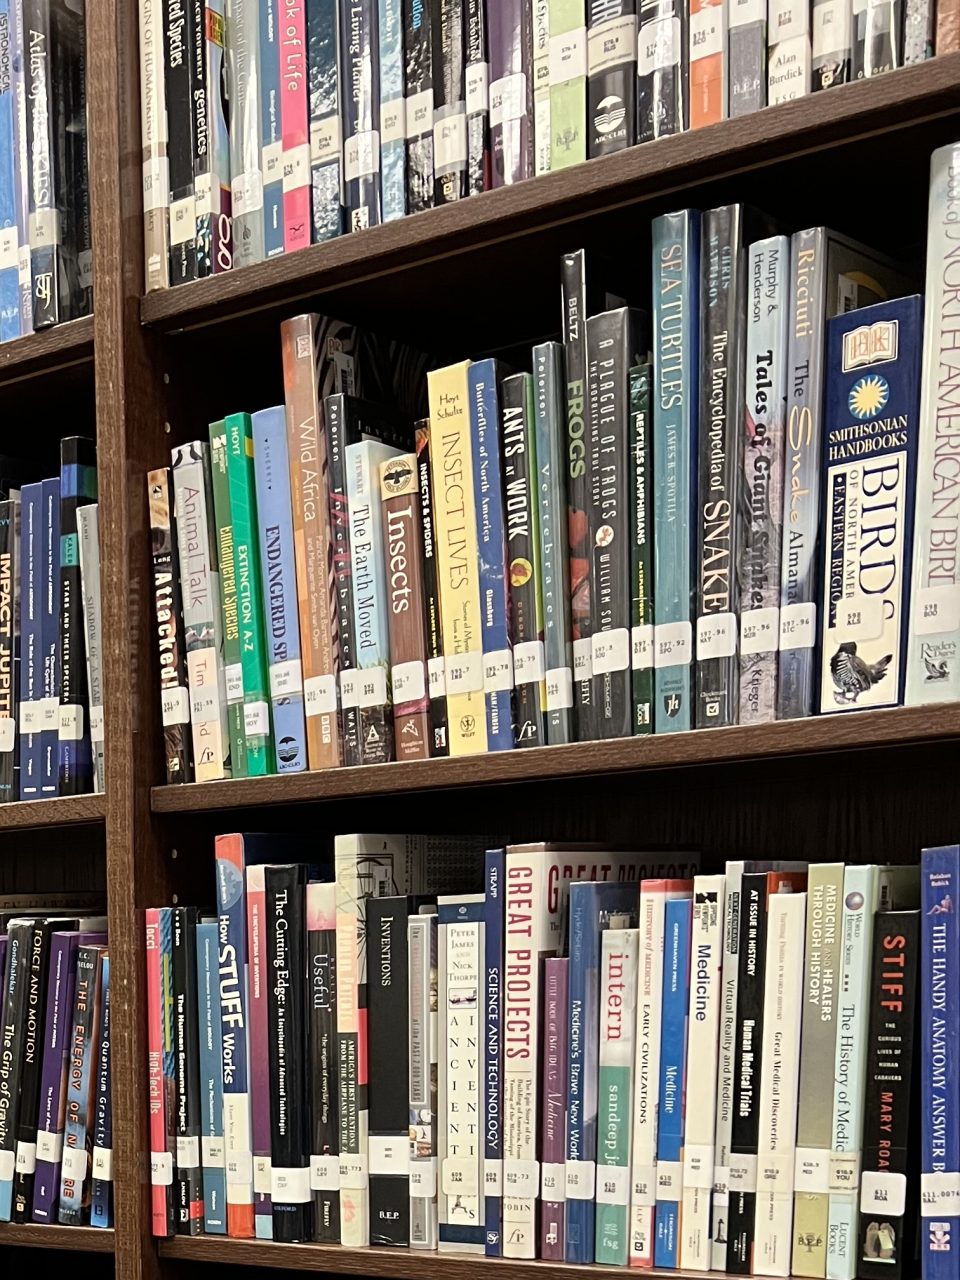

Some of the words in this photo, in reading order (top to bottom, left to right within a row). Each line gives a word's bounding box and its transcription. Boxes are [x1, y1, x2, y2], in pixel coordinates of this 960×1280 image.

[194, 89, 207, 155] genetics
[661, 244, 683, 293] SEA
[752, 253, 764, 324] Henderson
[767, 248, 780, 300] Murphy
[795, 247, 815, 338] Ricciuti
[569, 298, 577, 342] BELTZ
[712, 330, 728, 361] The
[661, 296, 683, 410] TURTLES
[793, 359, 810, 397] The
[599, 358, 616, 422] PLAGUE
[756, 350, 774, 414] Tales
[299, 416, 316, 466] Wild
[503, 407, 524, 457] ANTS
[568, 380, 586, 479] FROGS
[635, 413, 644, 459] REPTILES
[709, 365, 728, 473] Encyclopedia
[829, 415, 908, 444] SMITHSONIAN
[829, 430, 908, 460] HANDBOOKS
[420, 464, 431, 500] INSECTS
[442, 432, 465, 519] INSECT
[751, 450, 771, 519] Giant
[788, 406, 813, 524] Snake
[302, 470, 317, 523] Africa
[506, 478, 528, 541] WORK
[601, 465, 616, 520] FROGS
[637, 473, 645, 545] AMPHIBIANS
[353, 504, 369, 538] The
[424, 514, 433, 558] SPIDERS
[481, 497, 490, 542] America
[848, 498, 858, 550] NORTH
[265, 525, 286, 636] ENDANGERED
[353, 541, 372, 592] Earth
[388, 505, 412, 614] Insects
[448, 523, 469, 590] LIVES
[0, 553, 12, 637] IMPACT
[238, 545, 251, 623] EXTINCTION
[242, 628, 254, 652] A-Z
[357, 599, 375, 649] Moved
[275, 890, 288, 914] The
[508, 866, 533, 938] GREAT
[811, 885, 824, 949] THROUGH
[824, 885, 837, 945] MEDICINE
[220, 915, 230, 944] How
[274, 917, 288, 966] Cutting
[933, 923, 946, 953] THE
[218, 944, 244, 1028] STUFF
[274, 970, 289, 1005] Edge:
[313, 954, 329, 1010] Useful
[489, 967, 499, 1023] SCIENCE
[607, 953, 623, 1041] intern
[695, 944, 712, 1021] Medicine
[725, 980, 735, 1011] Virtual
[808, 952, 821, 1005] HISTORY
[820, 968, 833, 1021] HEALERS
[881, 935, 906, 1013] STIFF
[932, 957, 946, 1013] HANDY
[506, 949, 531, 1060] PROJECTS
[641, 1004, 650, 1038] EARLY
[723, 1014, 734, 1047] Reality
[841, 1004, 856, 1030] The
[6, 1024, 15, 1047] The
[26, 1009, 37, 1063] MOTION
[489, 1025, 499, 1056] AND
[743, 1020, 756, 1051] Human
[835, 1036, 854, 1084] History
[932, 1018, 946, 1087] ANATOMY
[1, 1051, 13, 1078] Grip
[640, 1042, 650, 1124] CIVILIZATIONS
[664, 1065, 677, 1114] Medicine
[741, 1051, 754, 1087] Medical
[179, 1094, 188, 1131] Project
[487, 1060, 499, 1150] TECHNOLOGY
[605, 1085, 618, 1152] sandeep
[721, 1074, 731, 1122] Medicine
[740, 1090, 752, 1117] Trials
[879, 1091, 893, 1132] MARY
[932, 1093, 946, 1157] ANSWER
